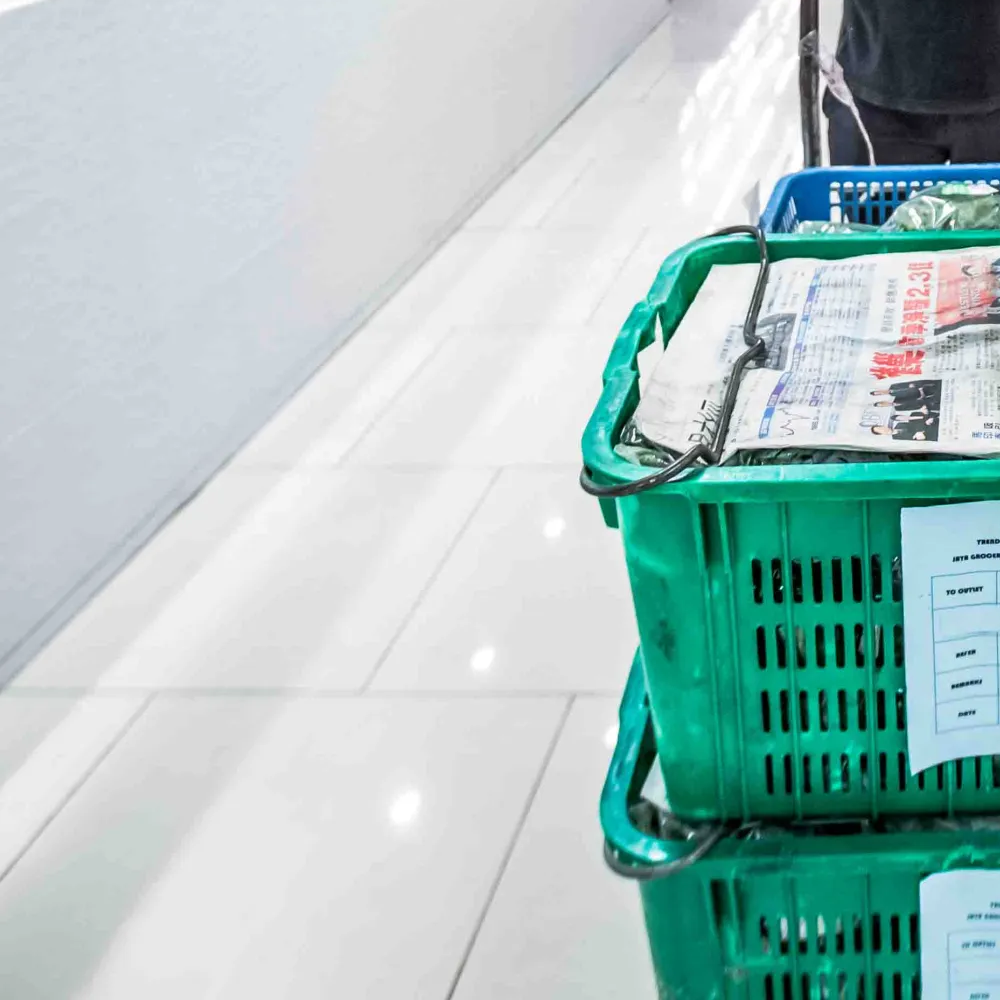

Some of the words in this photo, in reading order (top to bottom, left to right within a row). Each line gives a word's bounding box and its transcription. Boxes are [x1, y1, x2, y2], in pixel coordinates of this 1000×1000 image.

[952, 554, 969, 562] JAYA
[970, 552, 1000, 560] GROCER
[957, 585, 984, 595] OUTLET
